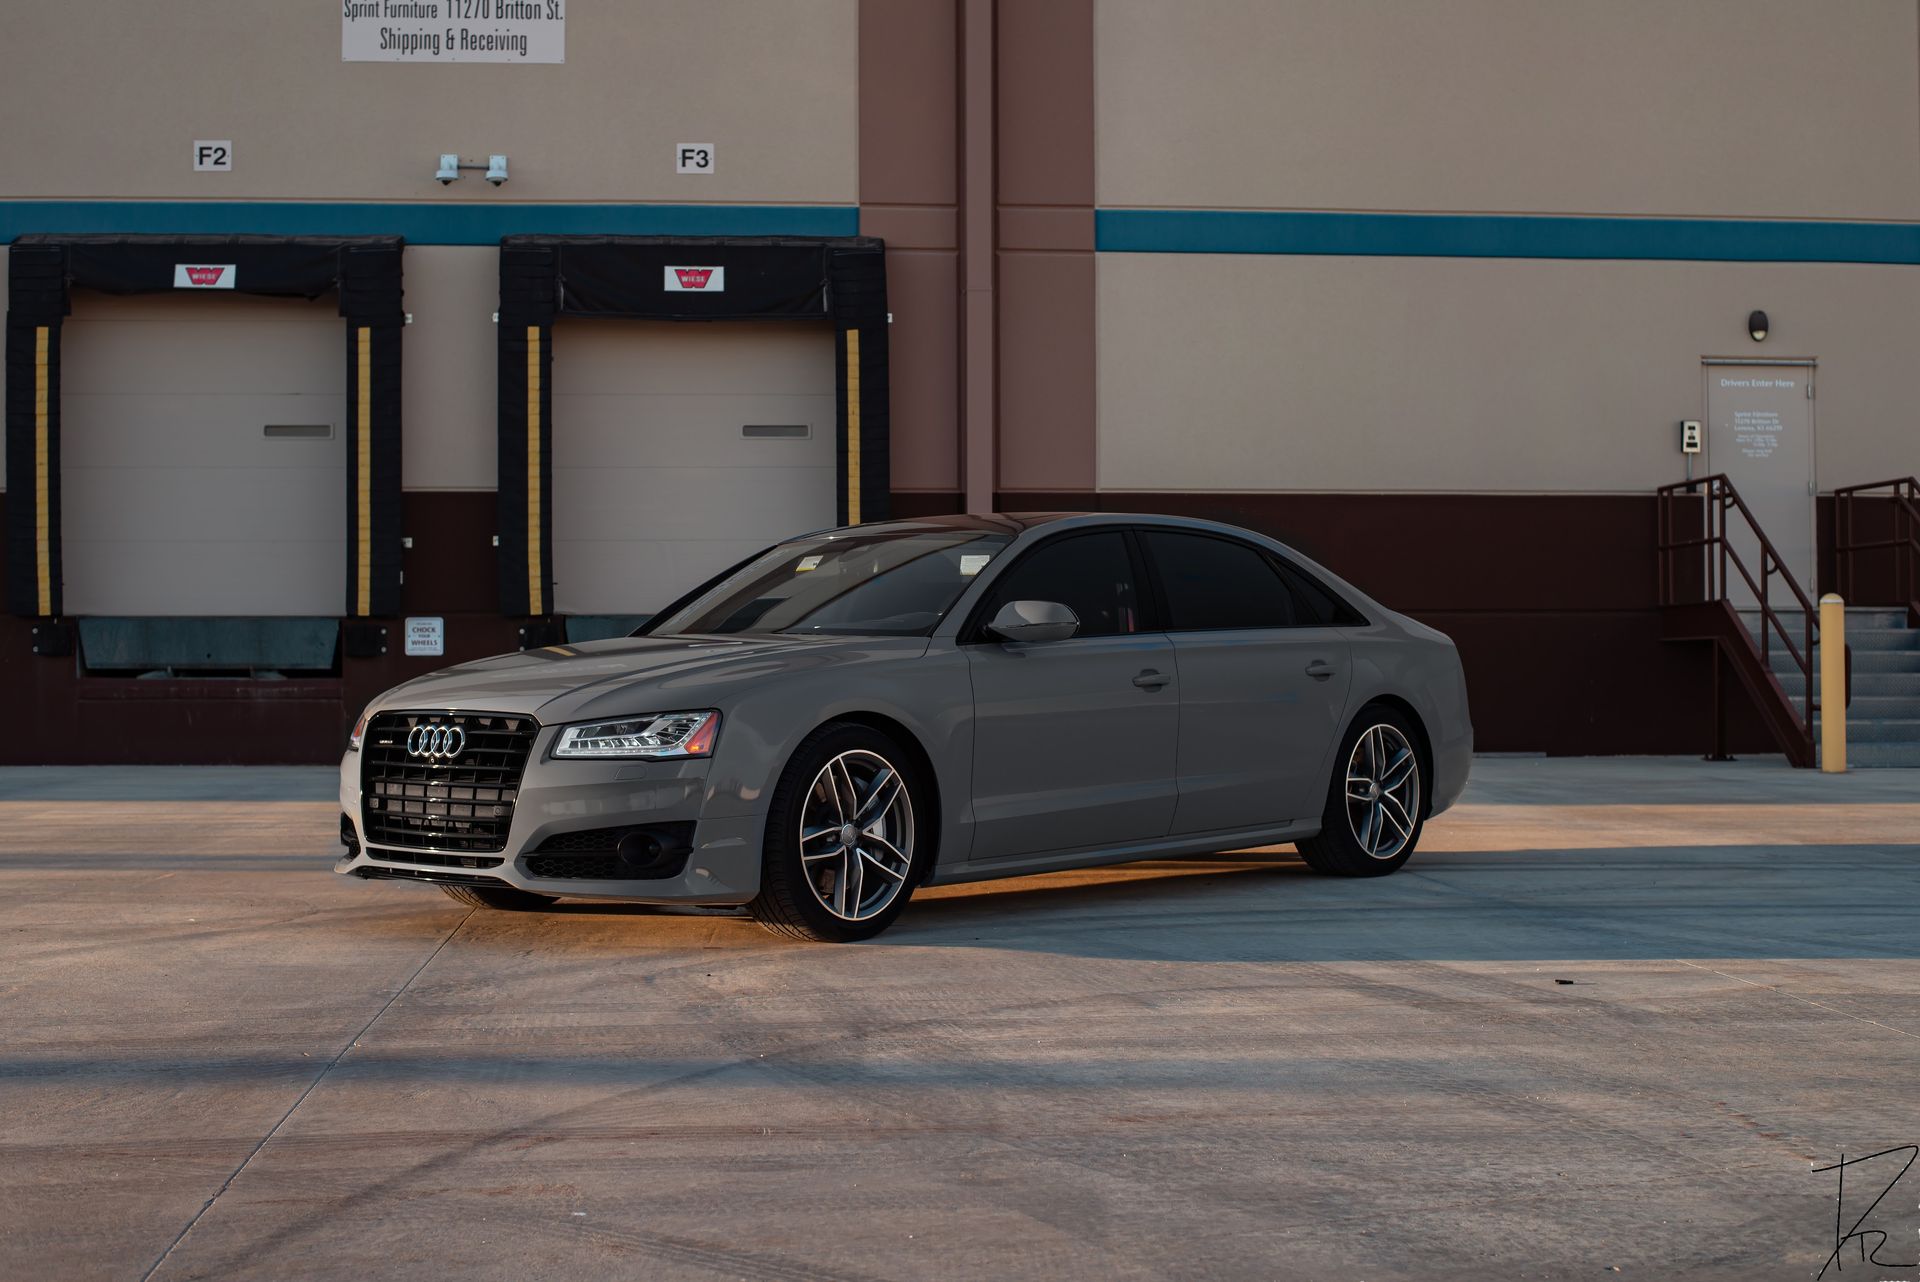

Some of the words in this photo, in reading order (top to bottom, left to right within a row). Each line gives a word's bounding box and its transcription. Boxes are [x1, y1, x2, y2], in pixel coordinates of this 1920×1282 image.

[344, 0, 380, 22] Sprint
[384, 0, 438, 19] Furniture
[496, 0, 541, 20] Britton
[546, 0, 564, 21] St.
[380, 27, 440, 55] Shipping
[446, 28, 455, 50] &
[460, 28, 527, 56] Receiving
[199, 146, 226, 166] F2
[682, 148, 709, 168] F3
[1720, 378, 1750, 388] Drivers
[1751, 379, 1774, 388] Enter
[1775, 379, 1795, 388] Here
